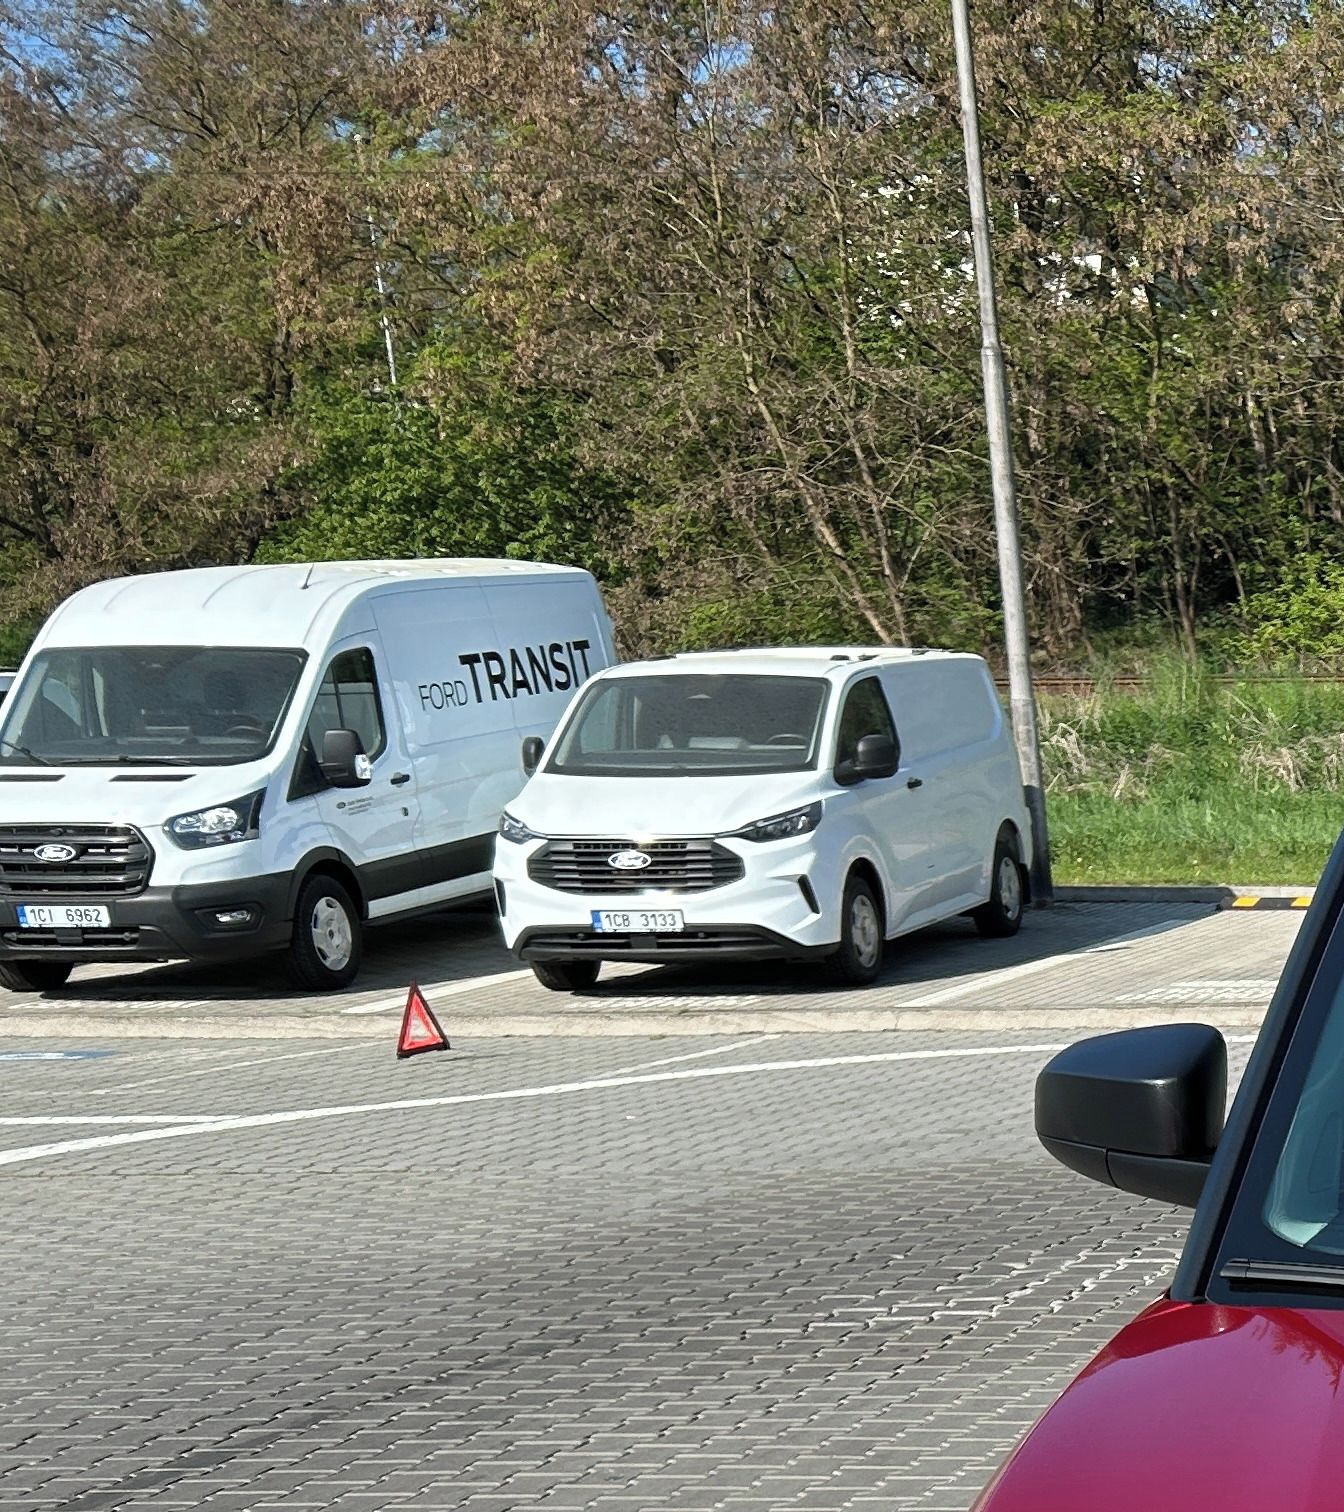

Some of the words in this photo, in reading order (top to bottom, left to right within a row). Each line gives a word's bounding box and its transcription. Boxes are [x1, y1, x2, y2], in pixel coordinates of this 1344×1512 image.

[418, 680, 468, 711] FORD
[458, 639, 591, 704] TRANSIT
[65, 908, 102, 923] 6962
[605, 914, 630, 927] 1CB
[640, 913, 676, 927] 3133
